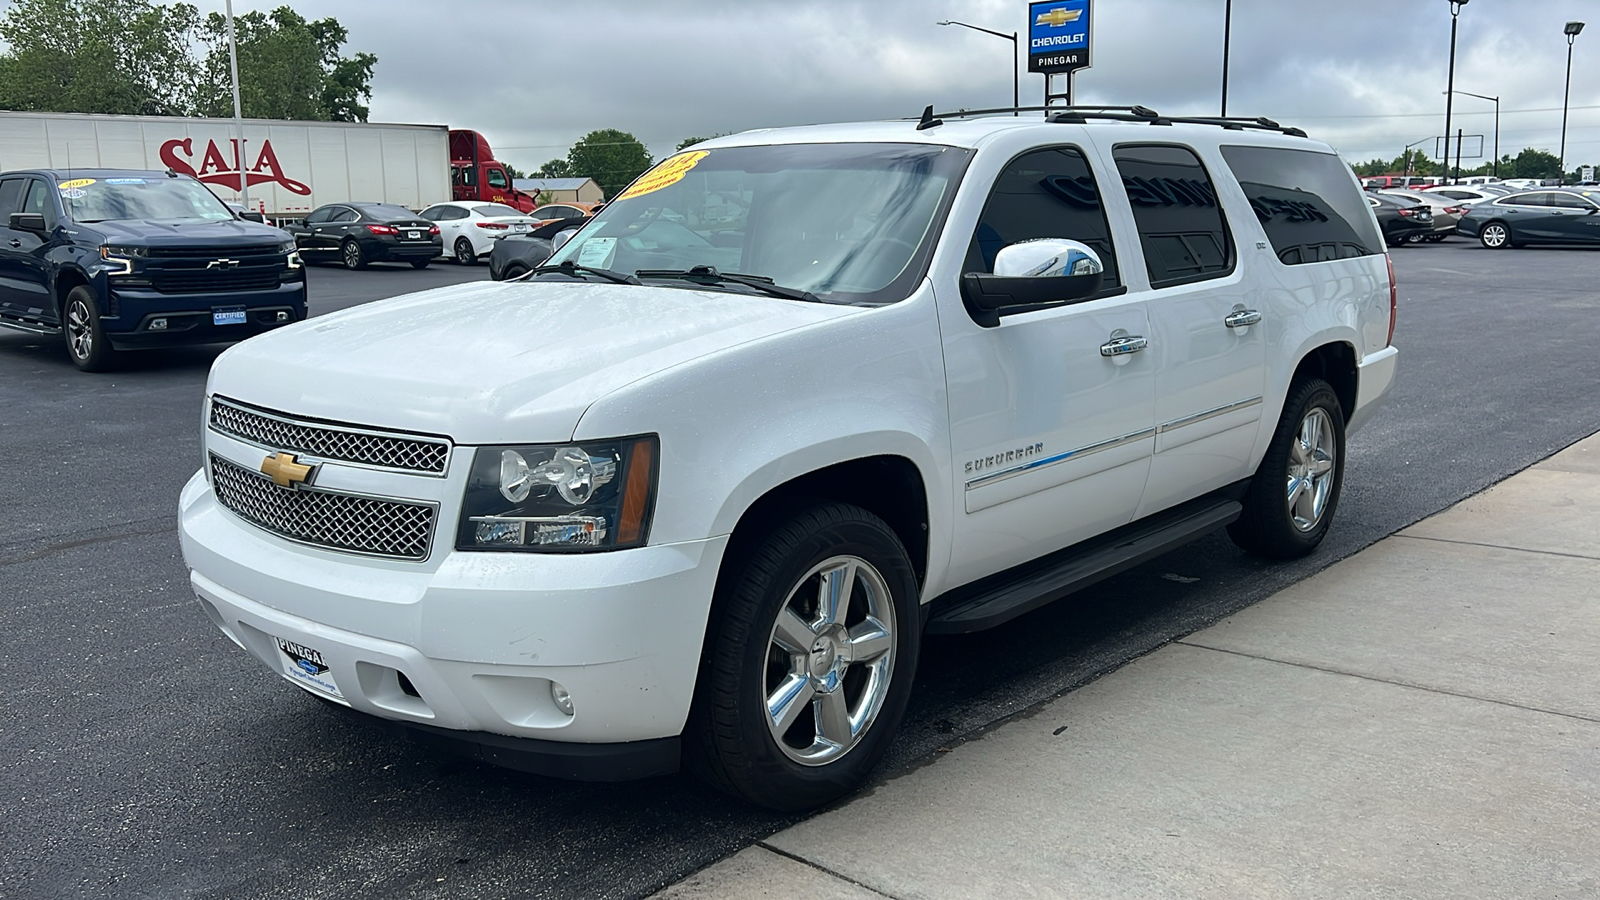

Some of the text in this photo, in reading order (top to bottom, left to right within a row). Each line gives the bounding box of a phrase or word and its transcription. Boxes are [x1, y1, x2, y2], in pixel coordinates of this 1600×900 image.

[1031, 33, 1085, 48] CHEVROLET
[1038, 54, 1078, 66] PINEGAR
[159, 137, 312, 196] SAIA
[214, 311, 245, 320] CERTIFIED
[964, 442, 1044, 473] SUBURBAN
